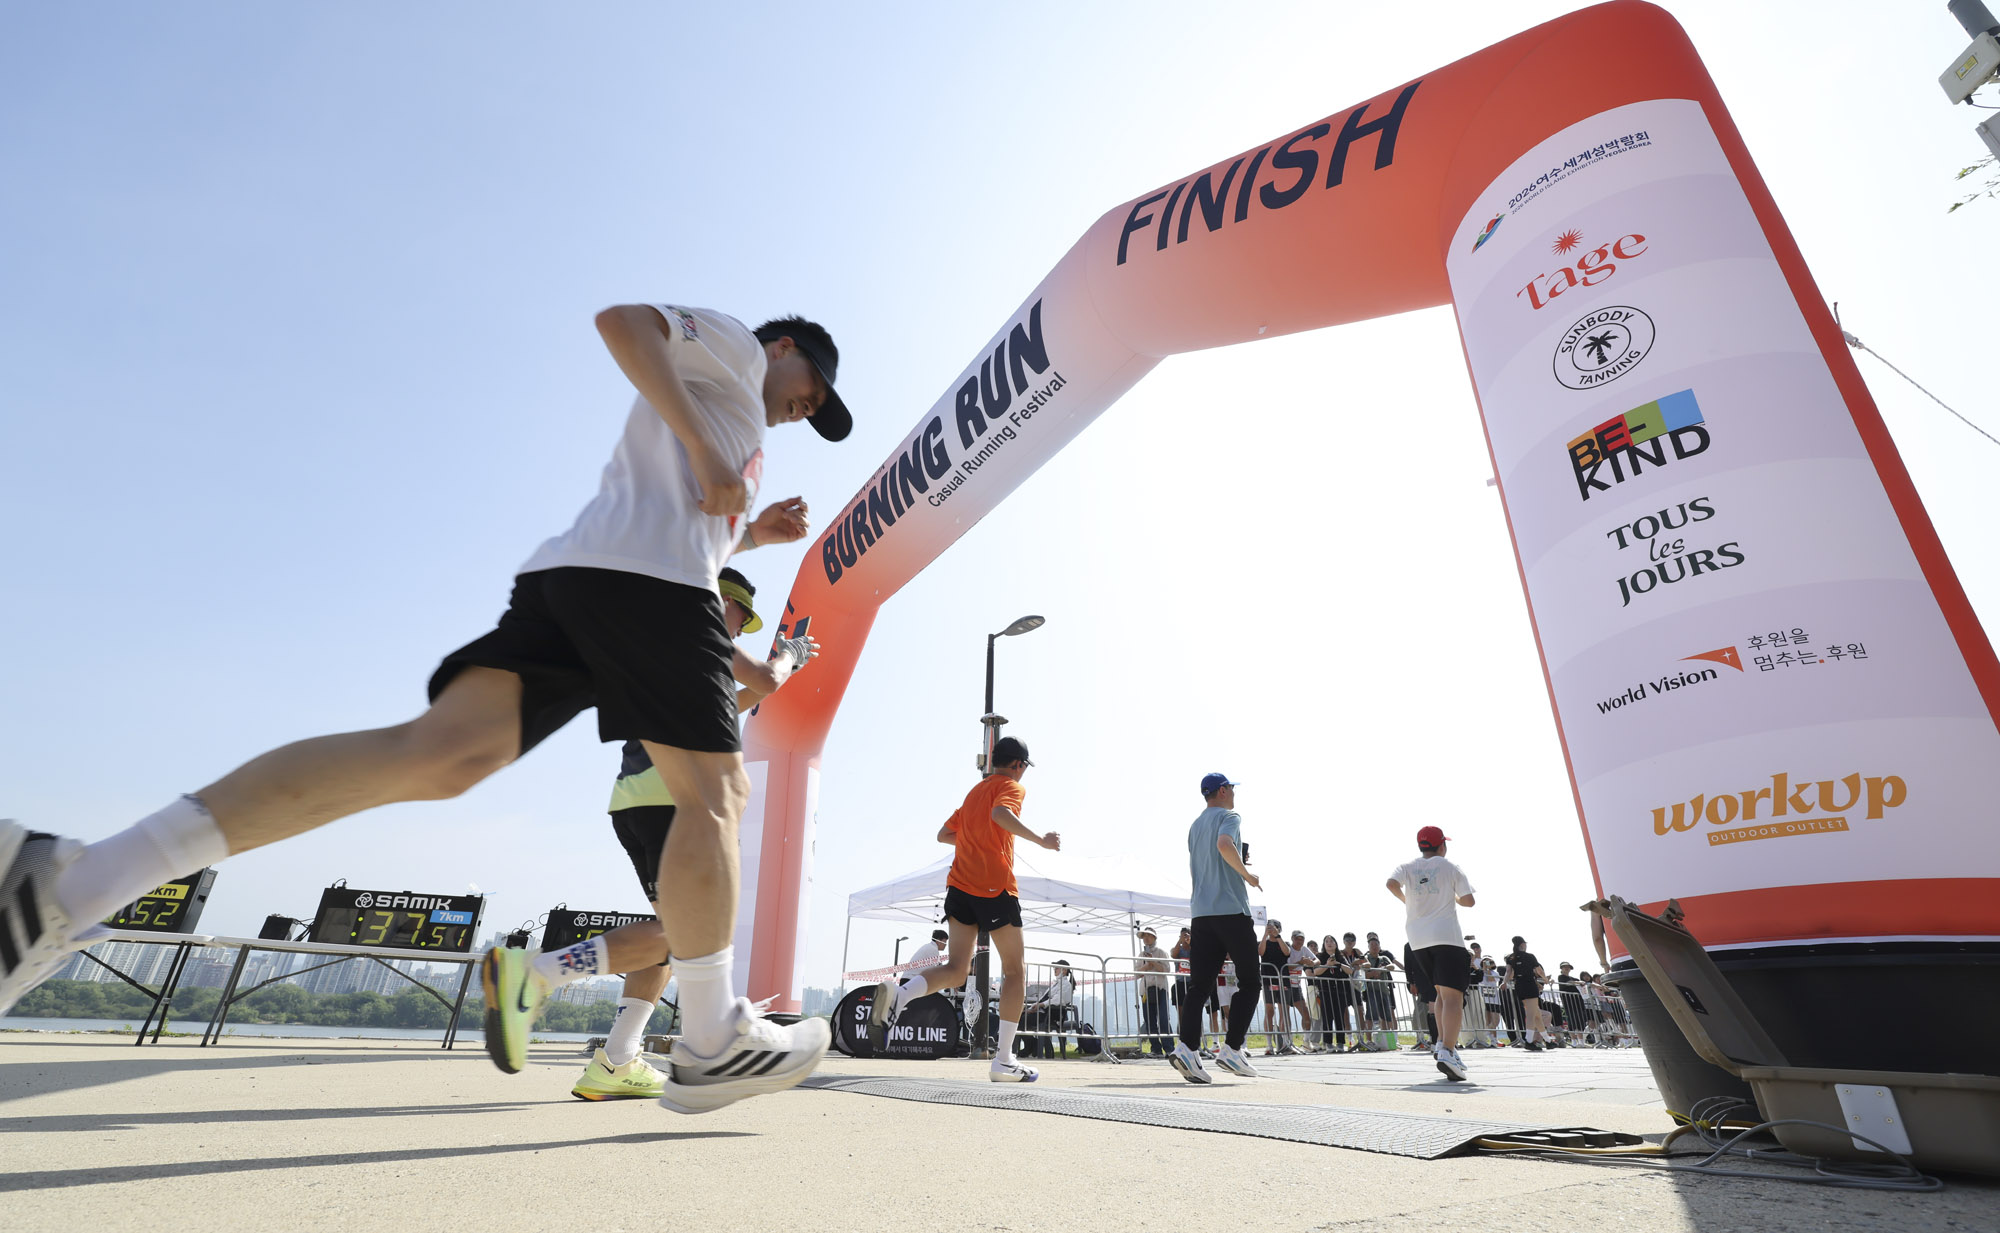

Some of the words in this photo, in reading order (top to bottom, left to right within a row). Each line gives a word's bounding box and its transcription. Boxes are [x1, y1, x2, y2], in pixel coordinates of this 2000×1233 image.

[1116, 79, 1424, 266] FINISH
[1508, 131, 1650, 209] 2026여수세계섬박람회
[1524, 188, 1545, 205] WORLD
[1545, 174, 1567, 190] ISLAND
[1567, 156, 1604, 177] EXHIBITION
[1604, 147, 1628, 159] YEOSU
[1628, 141, 1652, 150] KOREA
[1561, 310, 1635, 353] SUNBODY
[1579, 349, 1641, 386] TANNING
[823, 415, 953, 586] BURNING
[955, 297, 1051, 451] RUN
[928, 469, 967, 508] Casual
[961, 424, 1017, 476] Running
[1008, 371, 1067, 428] Festival
[1577, 424, 1711, 501] KIND
[1606, 496, 1716, 551] TOUS
[1649, 538, 1686, 562] les
[1616, 541, 1745, 608] JOURS
[1747, 627, 1810, 651] 후원을
[1596, 683, 1647, 715] World
[1649, 667, 1718, 695] Vision
[1711, 826, 1780, 843] OUTDOOR
[1786, 819, 1845, 834] OUTLET
[375, 894, 453, 910] SAMIK
[439, 912, 464, 922] 7km
[590, 914, 652, 927] SAM
[917, 1026, 947, 1042] LINE
